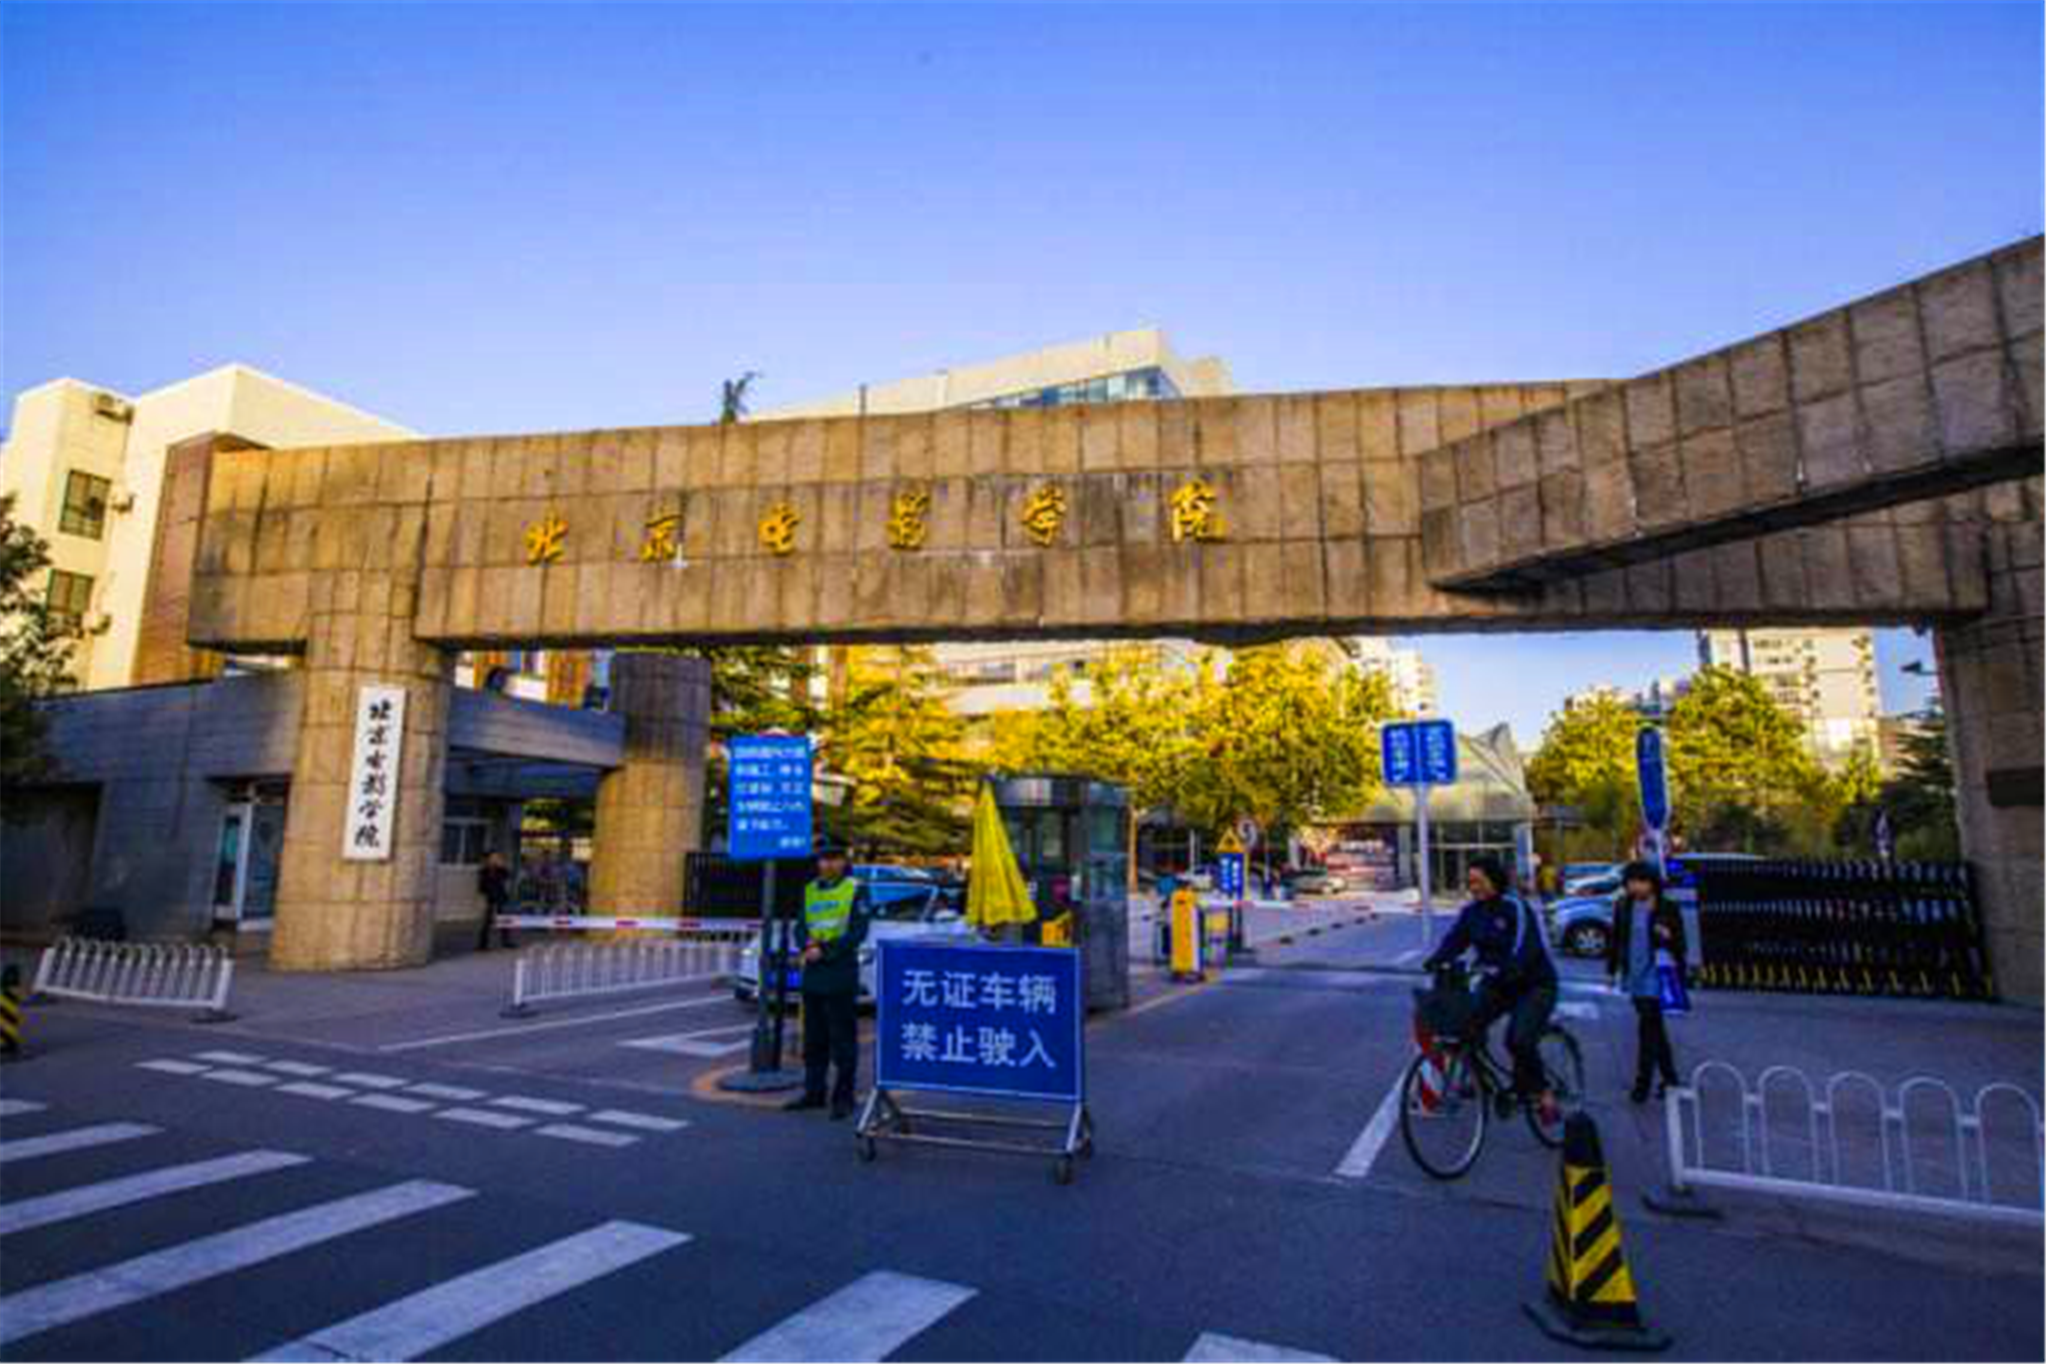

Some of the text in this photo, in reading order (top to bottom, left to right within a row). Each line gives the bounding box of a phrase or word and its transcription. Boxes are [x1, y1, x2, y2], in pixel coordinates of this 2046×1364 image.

[354, 698, 391, 848] 北京电影学院
[902, 969, 1057, 1014] 无证车辆
[900, 1022, 1057, 1068] 禁止驶入
